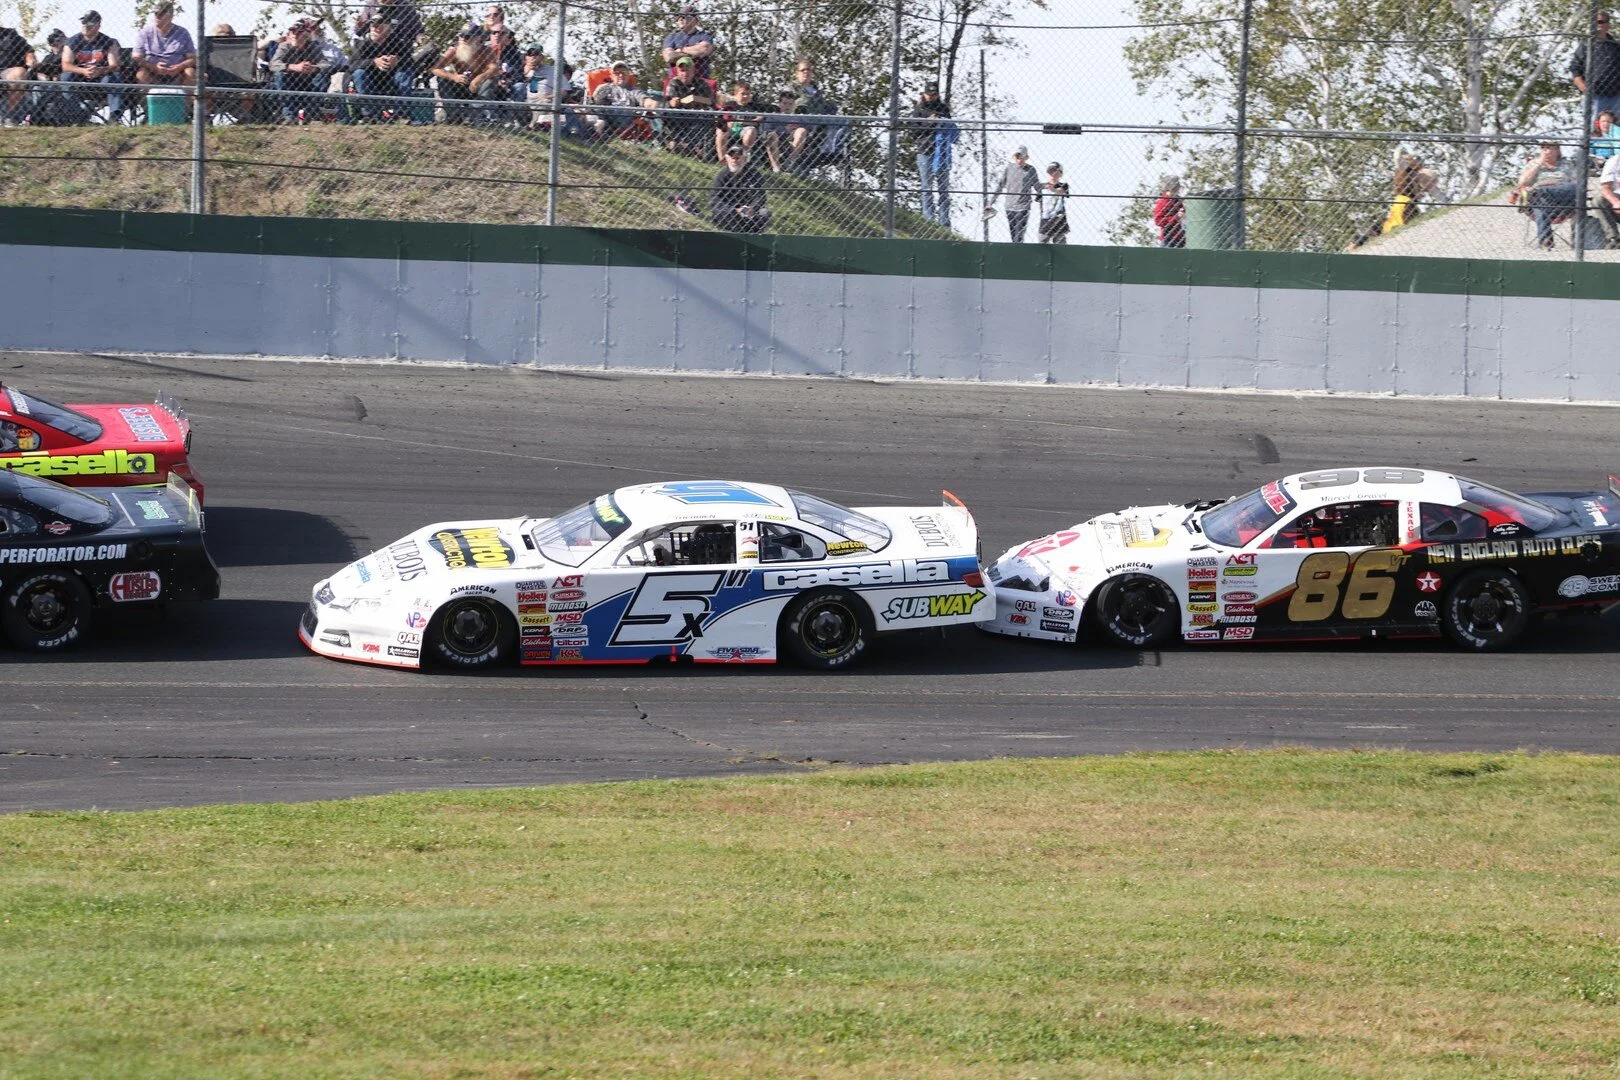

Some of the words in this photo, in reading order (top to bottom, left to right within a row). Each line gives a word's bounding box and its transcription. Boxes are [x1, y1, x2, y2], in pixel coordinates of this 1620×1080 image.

[1406, 501, 1415, 539] TEXACO
[827, 541, 866, 550] Newton
[1427, 544, 1455, 564] NEW
[1460, 541, 1519, 560] ENGLAND
[1523, 538, 1556, 557] AUTO
[1225, 553, 1257, 565] ACT
[1106, 562, 1153, 574] AMERICAN
[1188, 568, 1217, 578] Holley
[725, 569, 752, 588] VT
[764, 558, 949, 591] casella
[552, 575, 584, 589] ACT
[1288, 550, 1403, 622] 86
[450, 584, 497, 595] AMERICAN
[518, 592, 547, 601] Holley
[549, 602, 586, 610] MOROSO
[883, 591, 985, 622] SUBWAY
[1015, 600, 1036, 612] QA1
[556, 613, 582, 622] MSD
[1047, 609, 1070, 617] DRP
[397, 632, 419, 644] QA1
